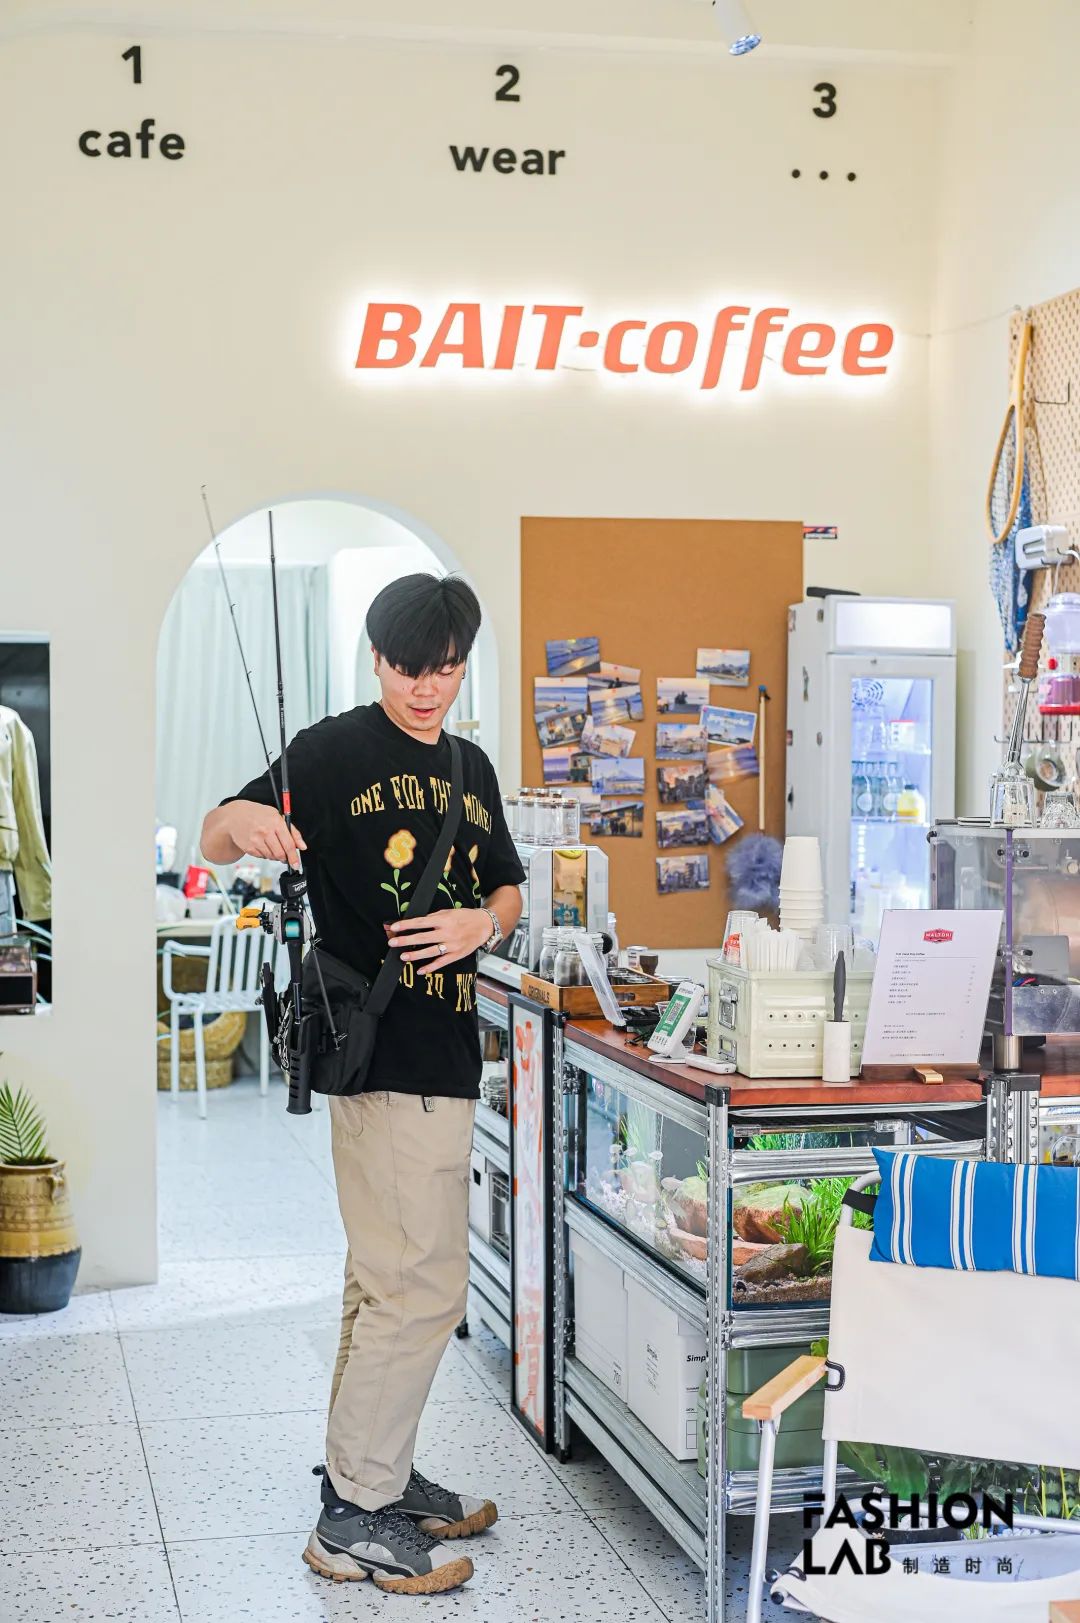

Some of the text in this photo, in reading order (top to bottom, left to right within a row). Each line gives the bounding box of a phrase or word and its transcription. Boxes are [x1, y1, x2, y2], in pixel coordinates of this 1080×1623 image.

[121, 45, 142, 84] 1
[495, 64, 521, 103] 2
[812, 82, 837, 119] 3
[78, 118, 185, 161] cafe
[449, 145, 566, 176] wear
[350, 782, 385, 816] ONE
[389, 774, 425, 810] FOR
